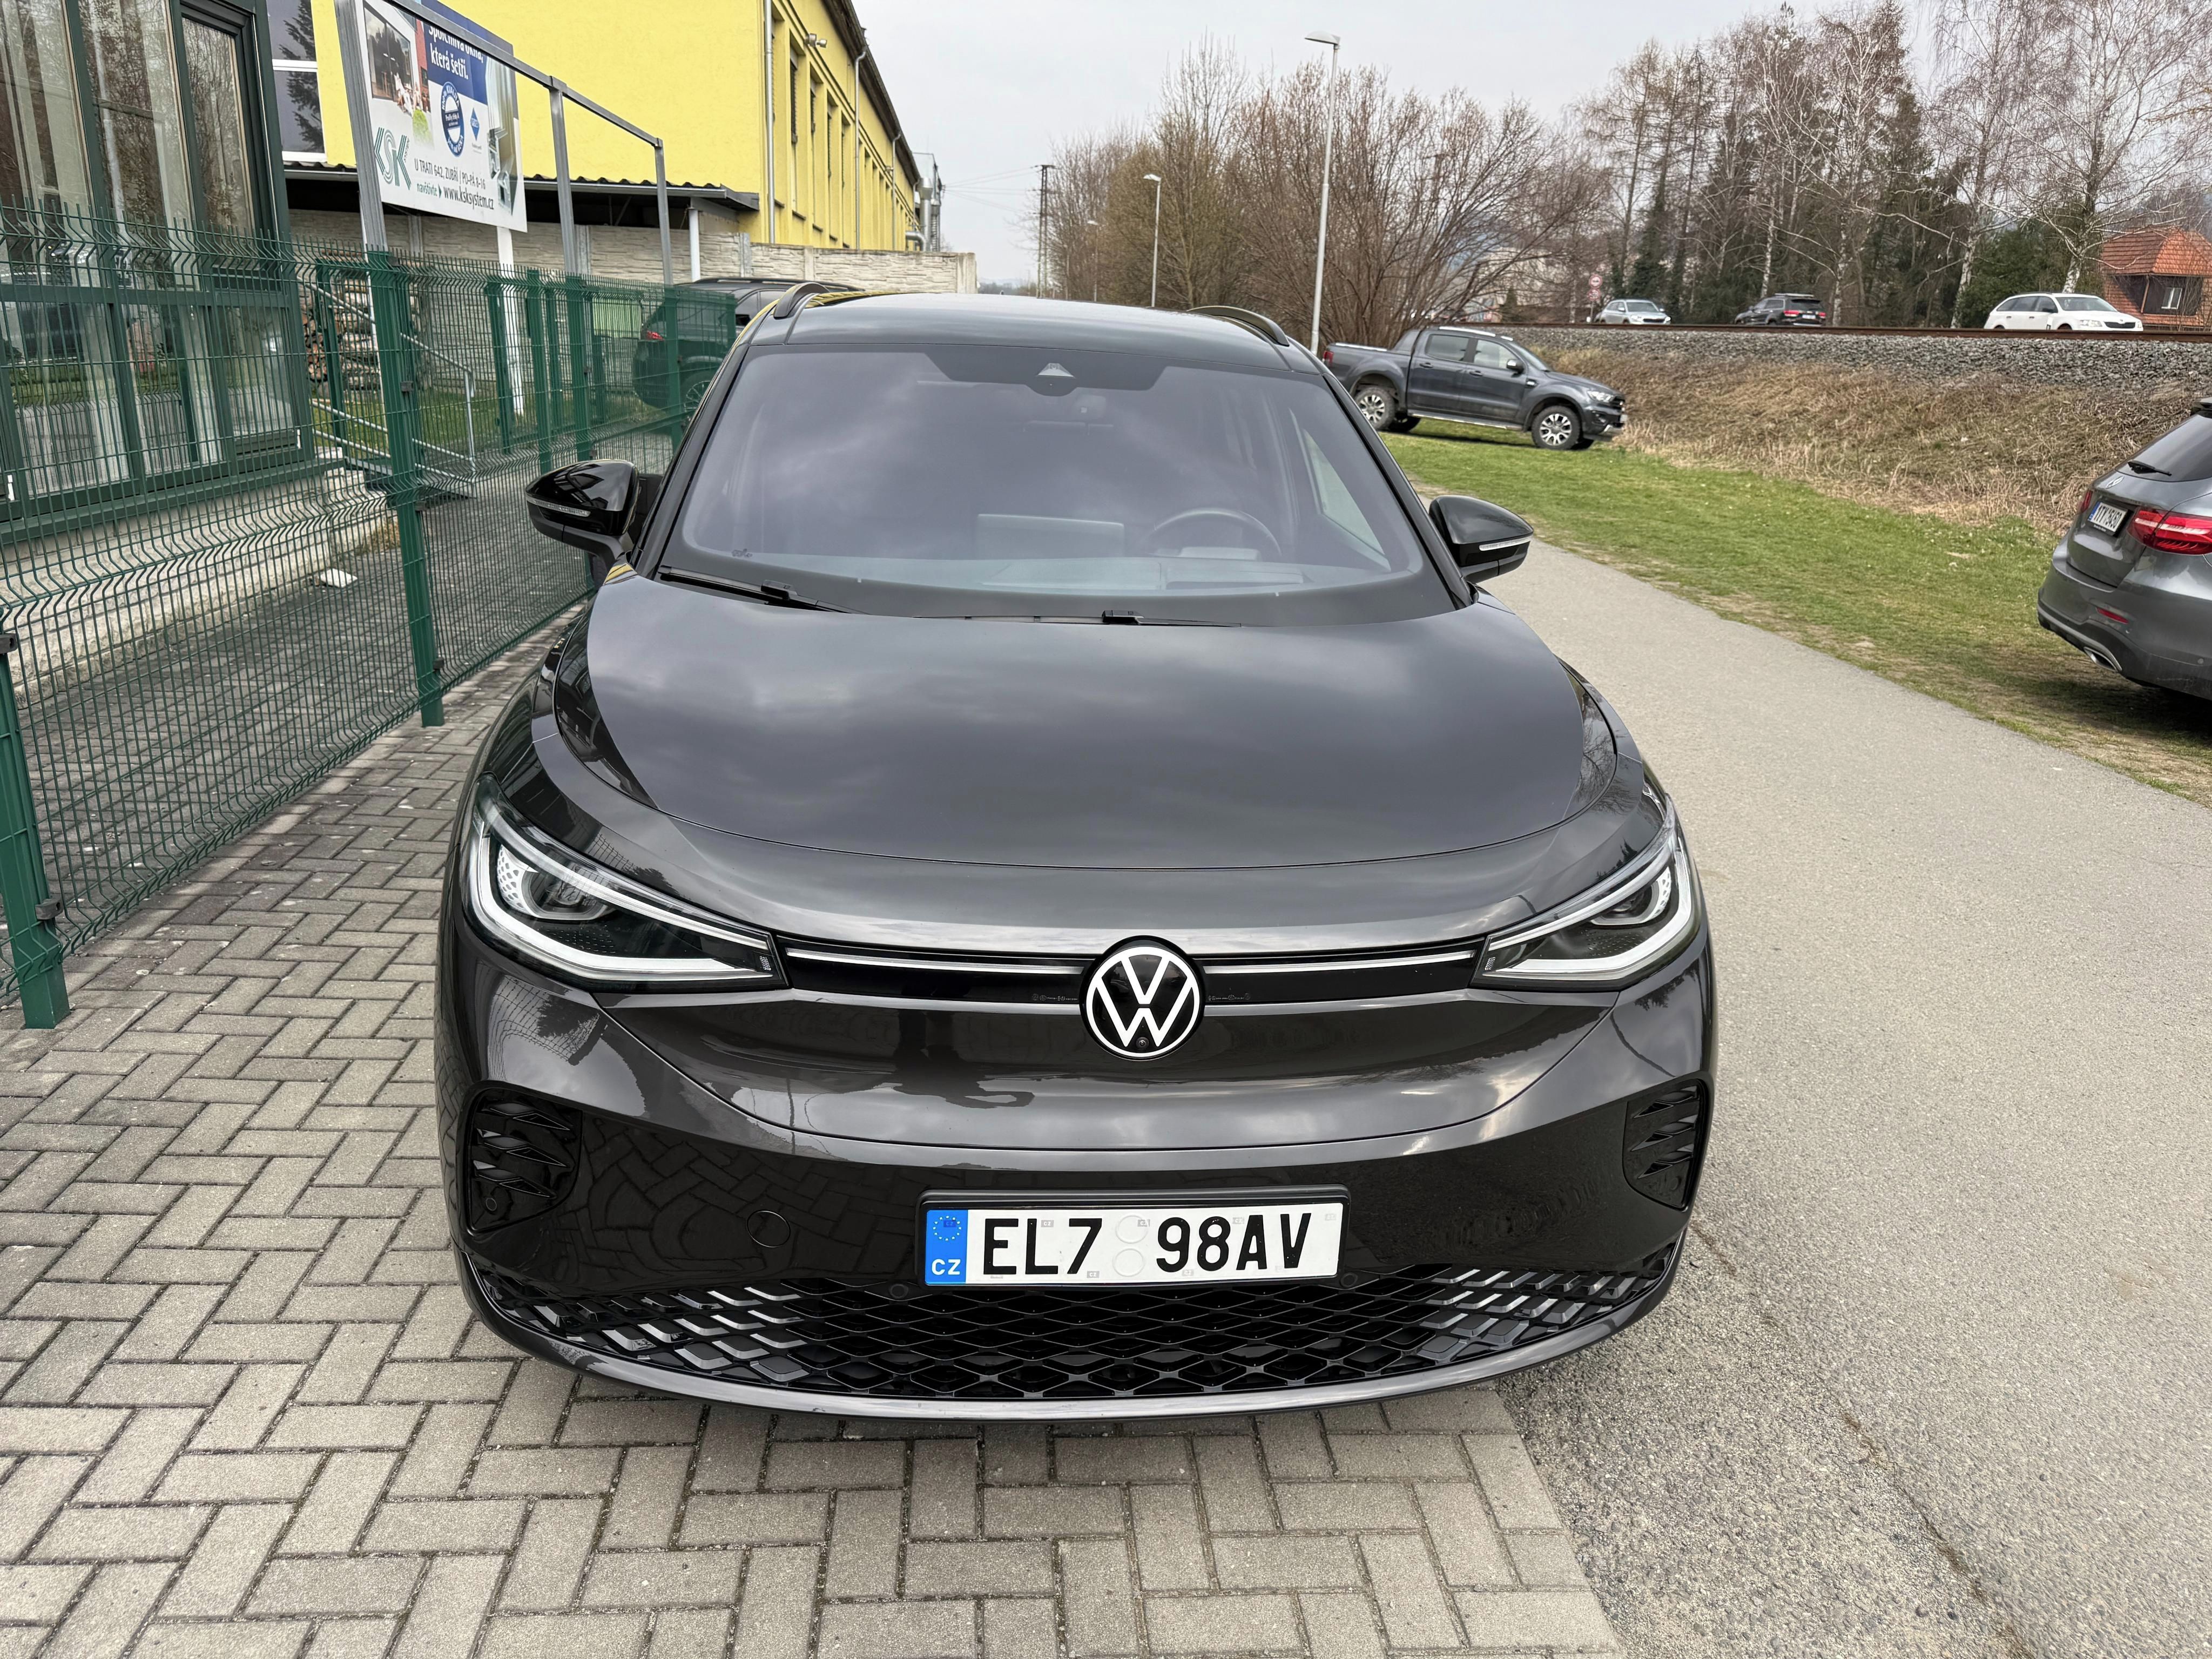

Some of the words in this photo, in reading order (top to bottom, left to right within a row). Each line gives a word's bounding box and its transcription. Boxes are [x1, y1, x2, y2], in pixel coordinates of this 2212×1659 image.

[430, 43, 450, 71] která
[450, 53, 469, 79] šetří.
[374, 127, 412, 191] KSK
[414, 158, 419, 171] U
[420, 160, 433, 175] TRATI
[443, 185, 494, 210] www.ksksystem.cz
[1092, 953, 1195, 1049] VW
[983, 1218, 1102, 1274] EL7
[1156, 1213, 1312, 1273] 98AV
[932, 1258, 961, 1275] CZ
